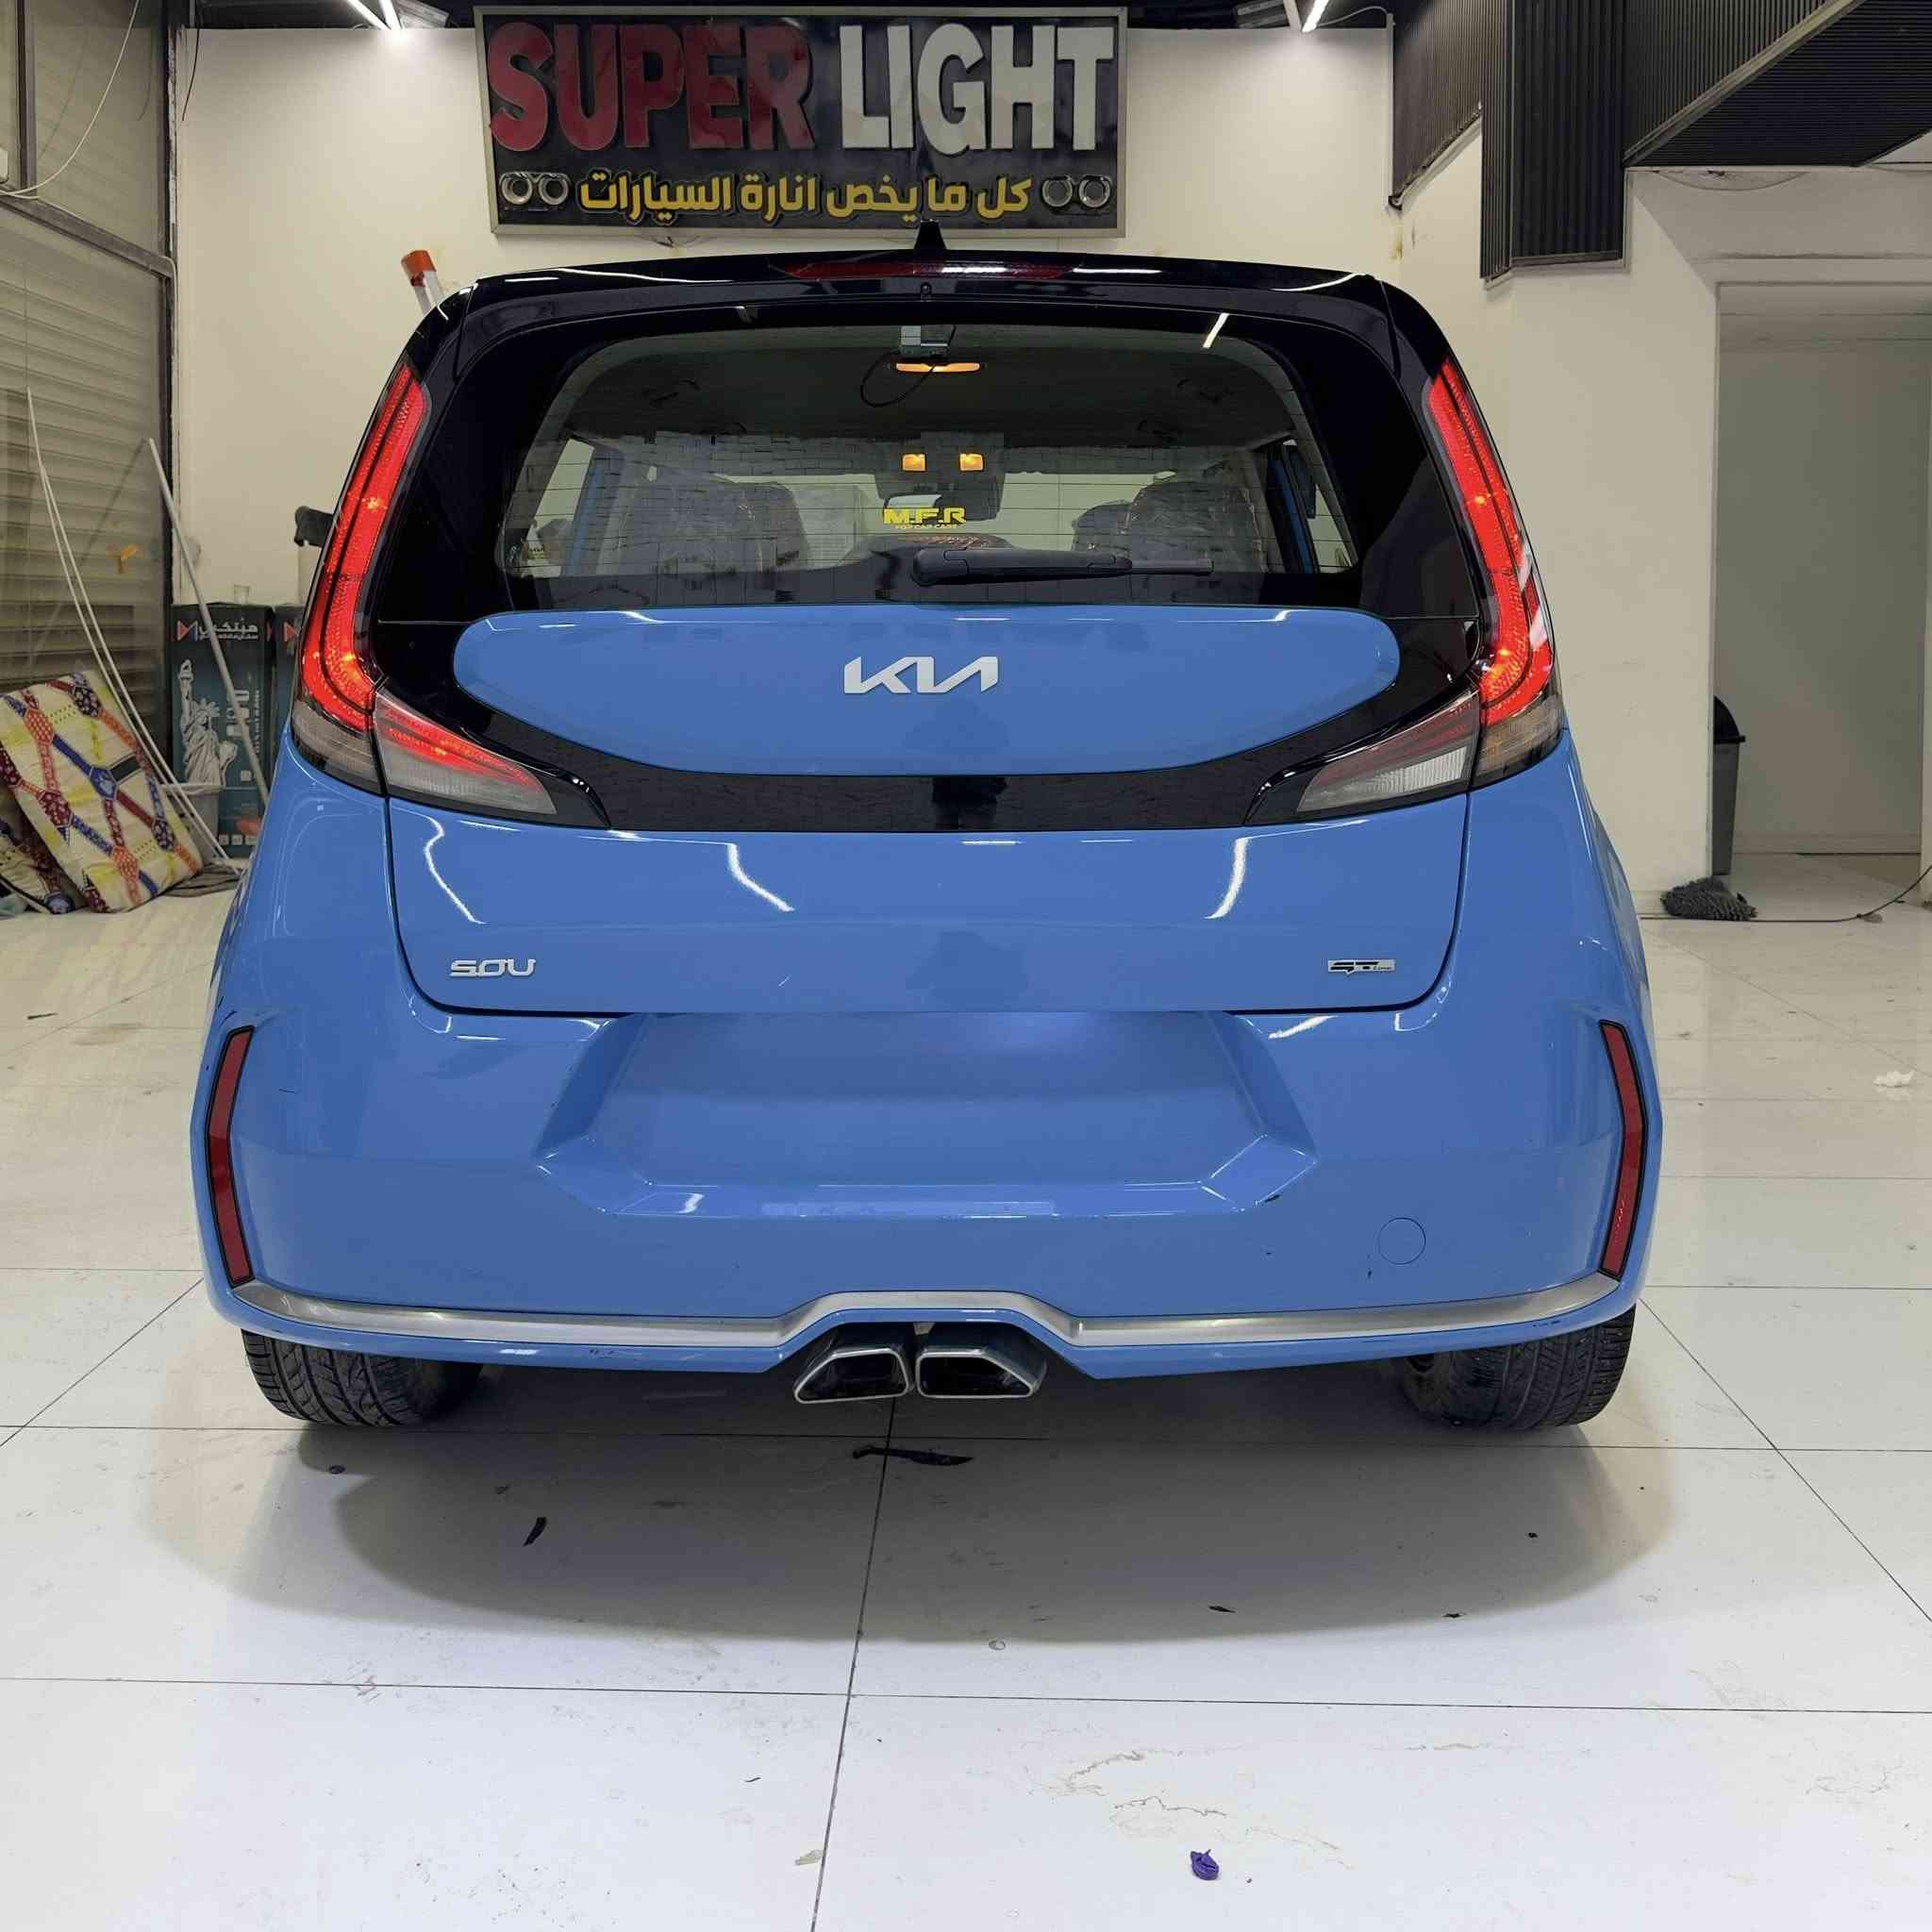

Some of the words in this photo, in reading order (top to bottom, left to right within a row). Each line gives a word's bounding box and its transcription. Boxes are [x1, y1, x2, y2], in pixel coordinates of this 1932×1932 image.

[487, 23, 816, 152] SUPER
[840, 23, 1114, 155] LIGHT
[580, 173, 732, 221] السيارات
[741, 174, 816, 222] انارة
[826, 175, 918, 223] يخص
[927, 176, 967, 212] ما
[977, 176, 1032, 219] كل
